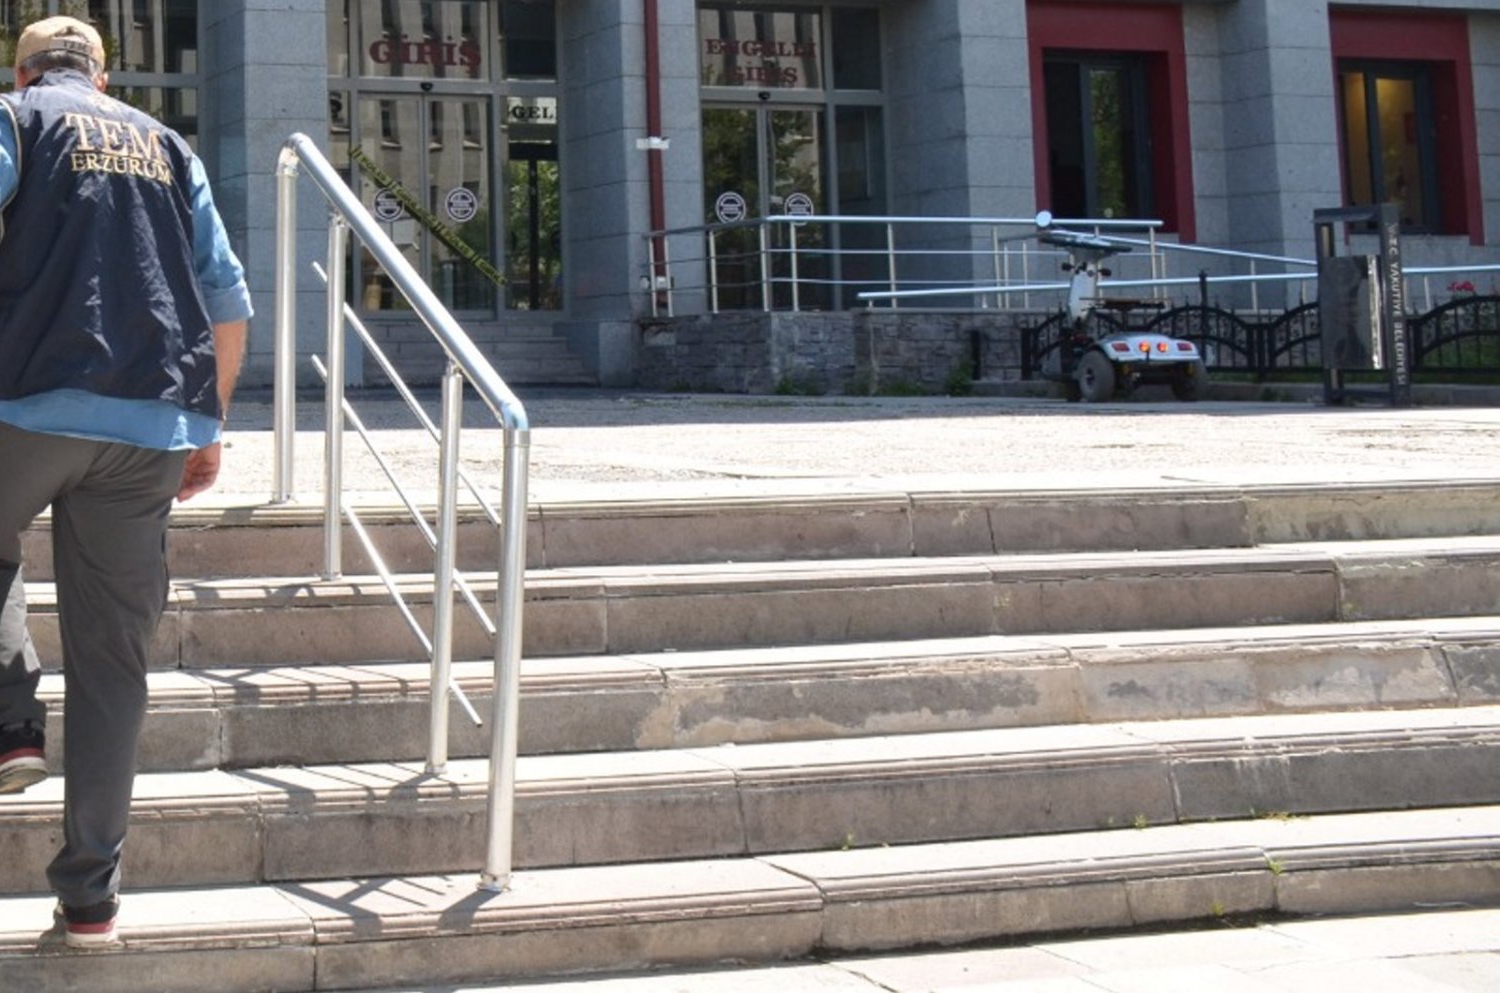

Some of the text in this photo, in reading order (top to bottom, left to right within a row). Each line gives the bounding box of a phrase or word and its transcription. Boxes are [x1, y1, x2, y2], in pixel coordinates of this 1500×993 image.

[369, 34, 481, 75] GİRİŞ
[64, 112, 162, 162] TEM
[70, 152, 173, 186] ERZURUM
